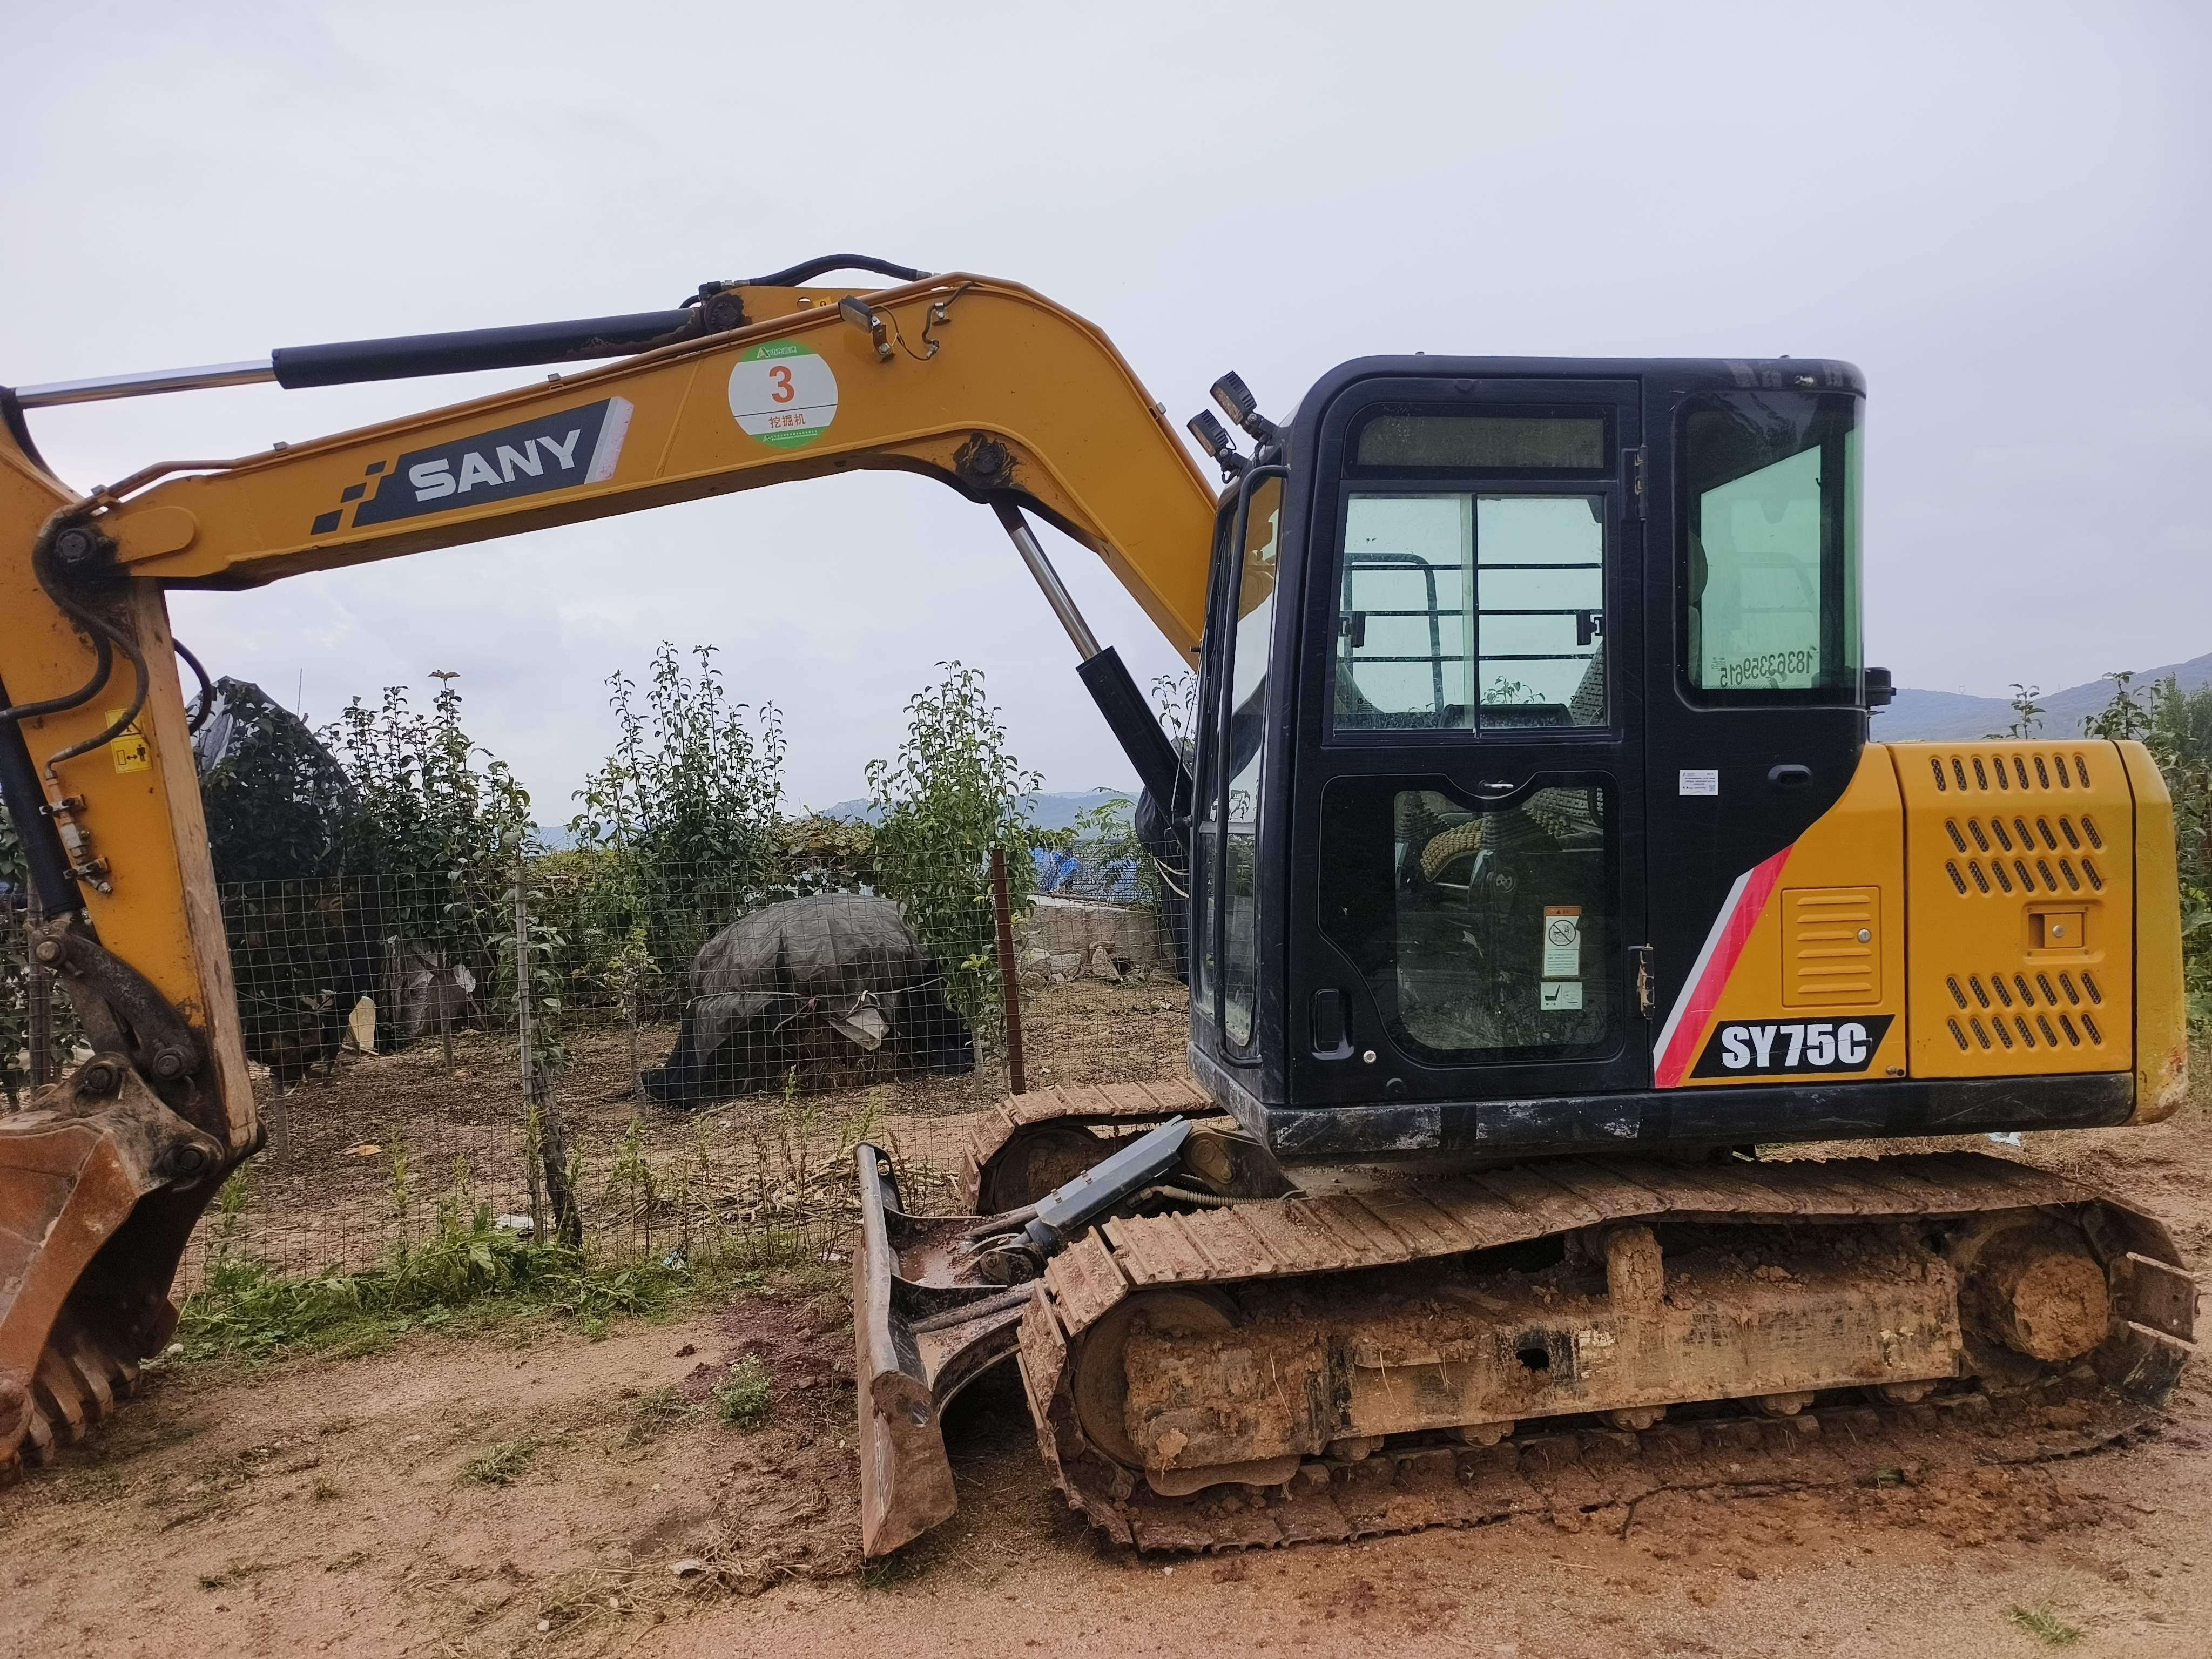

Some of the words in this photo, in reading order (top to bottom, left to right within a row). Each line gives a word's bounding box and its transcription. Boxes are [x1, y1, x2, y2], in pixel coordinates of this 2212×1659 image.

[768, 366, 795, 403] 3
[768, 414, 806, 428] 挖掘机
[409, 429, 581, 502] SANY
[1722, 1023, 1867, 1069] SY75C
